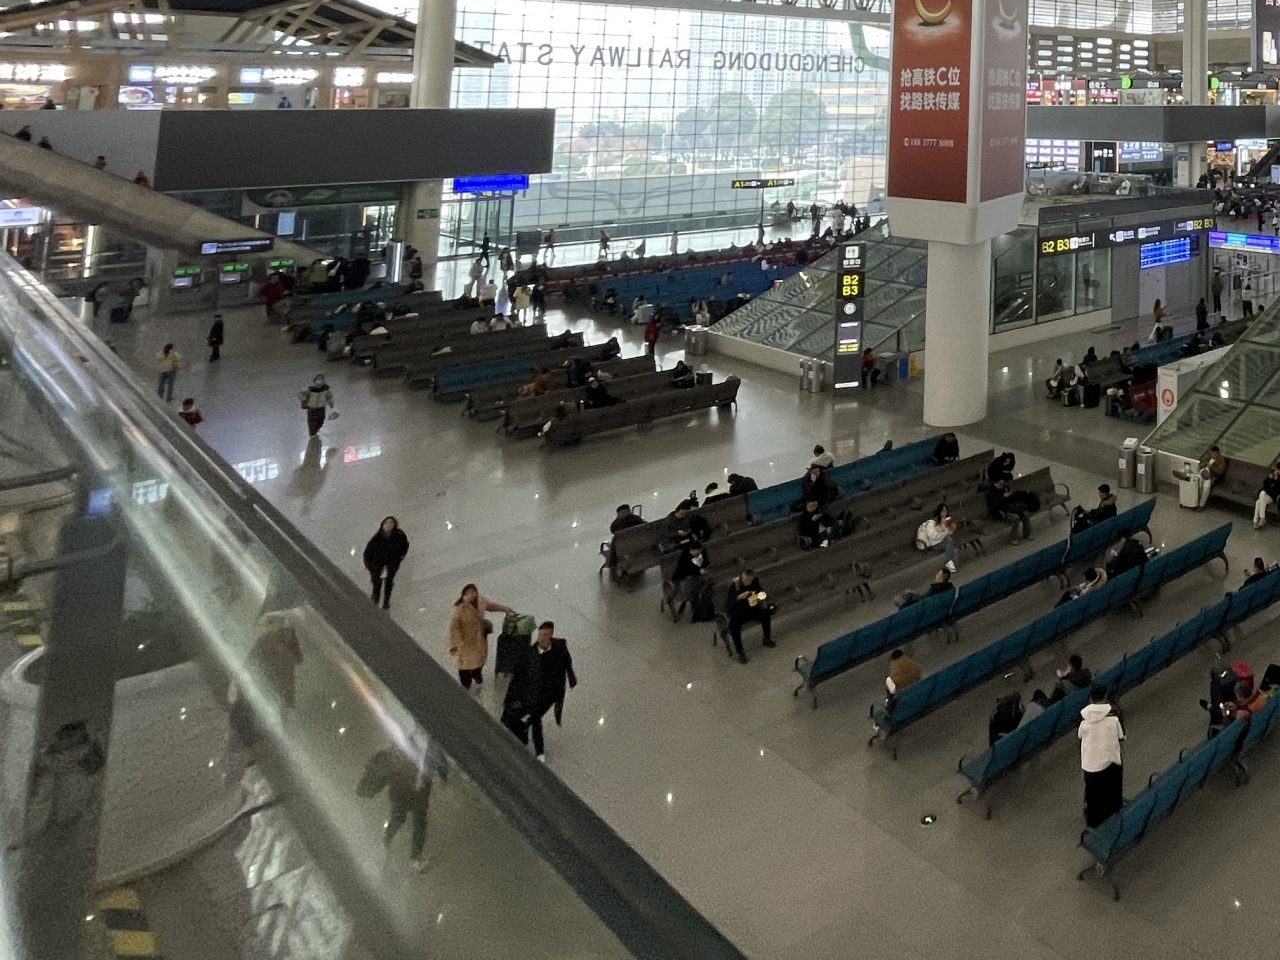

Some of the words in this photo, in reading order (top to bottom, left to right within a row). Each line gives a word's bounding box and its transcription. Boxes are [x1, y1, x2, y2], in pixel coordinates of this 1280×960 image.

[900, 66, 961, 87] 抢高铁C位
[900, 92, 961, 111] 找路铁传媒
[1193, 219, 1203, 230] B2
[1204, 217, 1213, 229] B3
[1041, 240, 1054, 253] B2
[1056, 239, 1070, 251] B3
[843, 275, 859, 285] B2
[842, 285, 858, 296] B3
